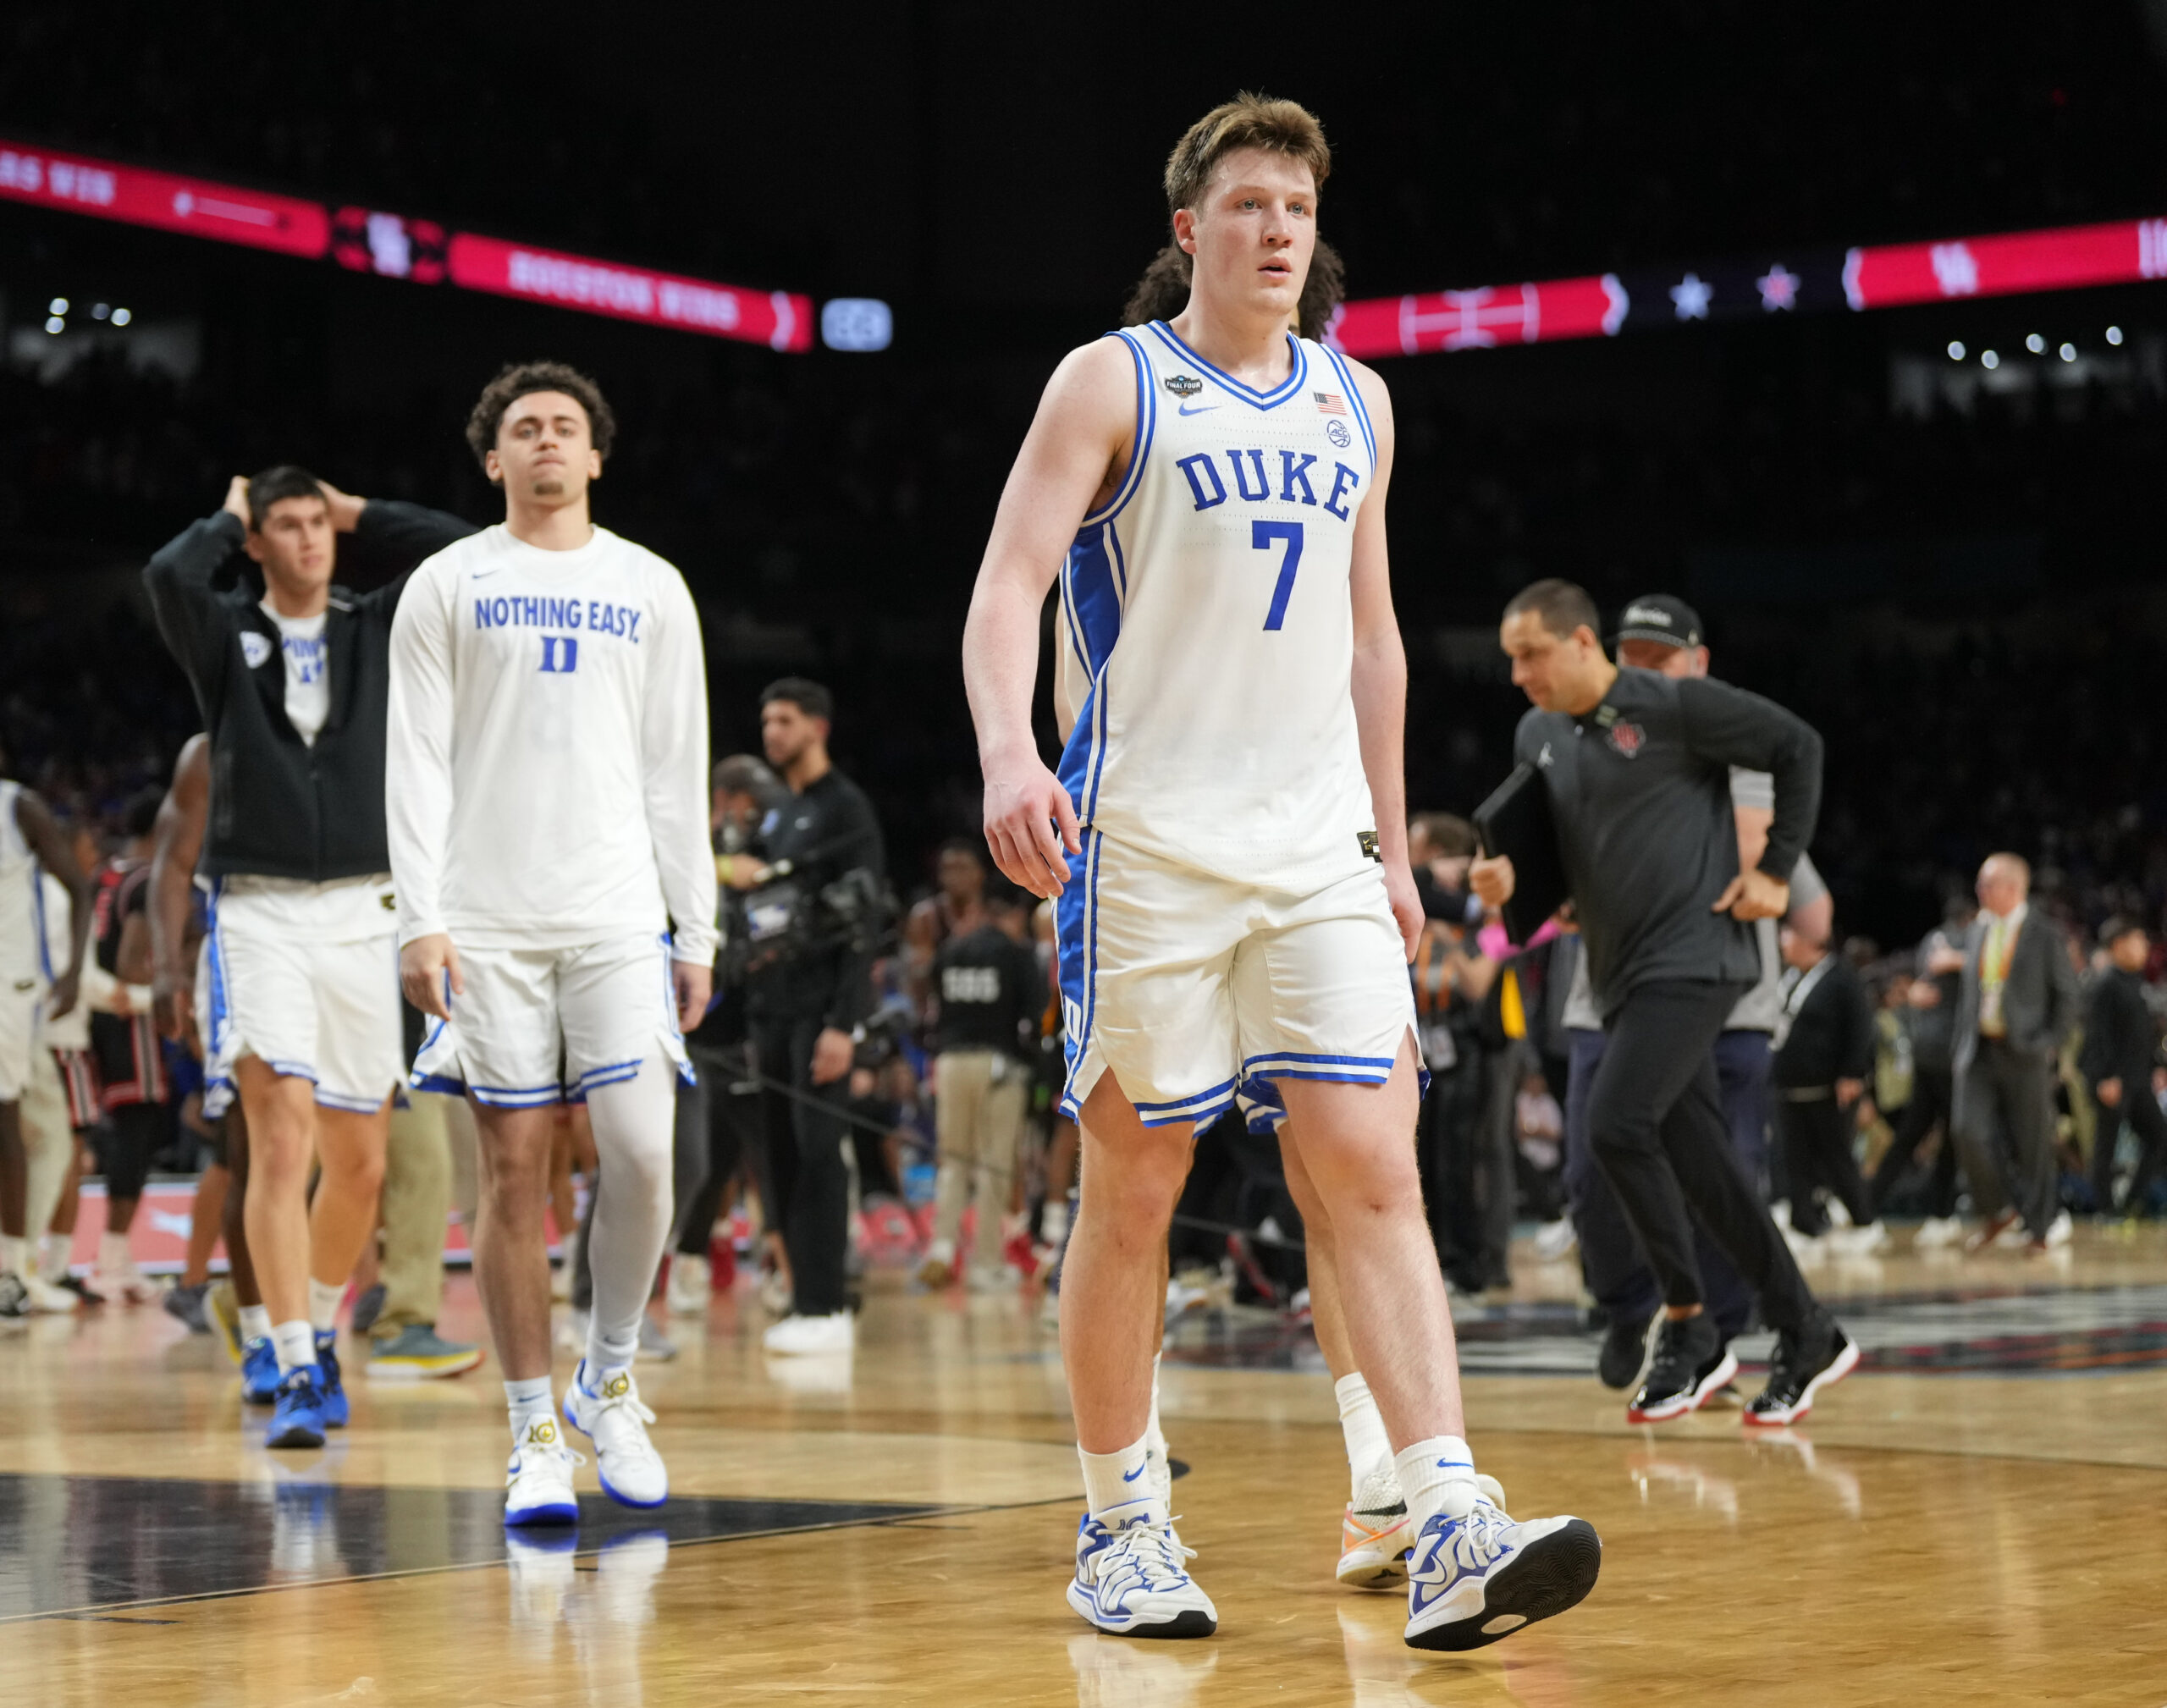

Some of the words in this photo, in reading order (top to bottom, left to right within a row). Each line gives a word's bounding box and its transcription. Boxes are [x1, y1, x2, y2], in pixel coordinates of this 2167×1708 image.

[1176, 449, 1359, 522] DUKE
[1252, 520, 1304, 631] 7
[475, 596, 582, 630] NOTHING
